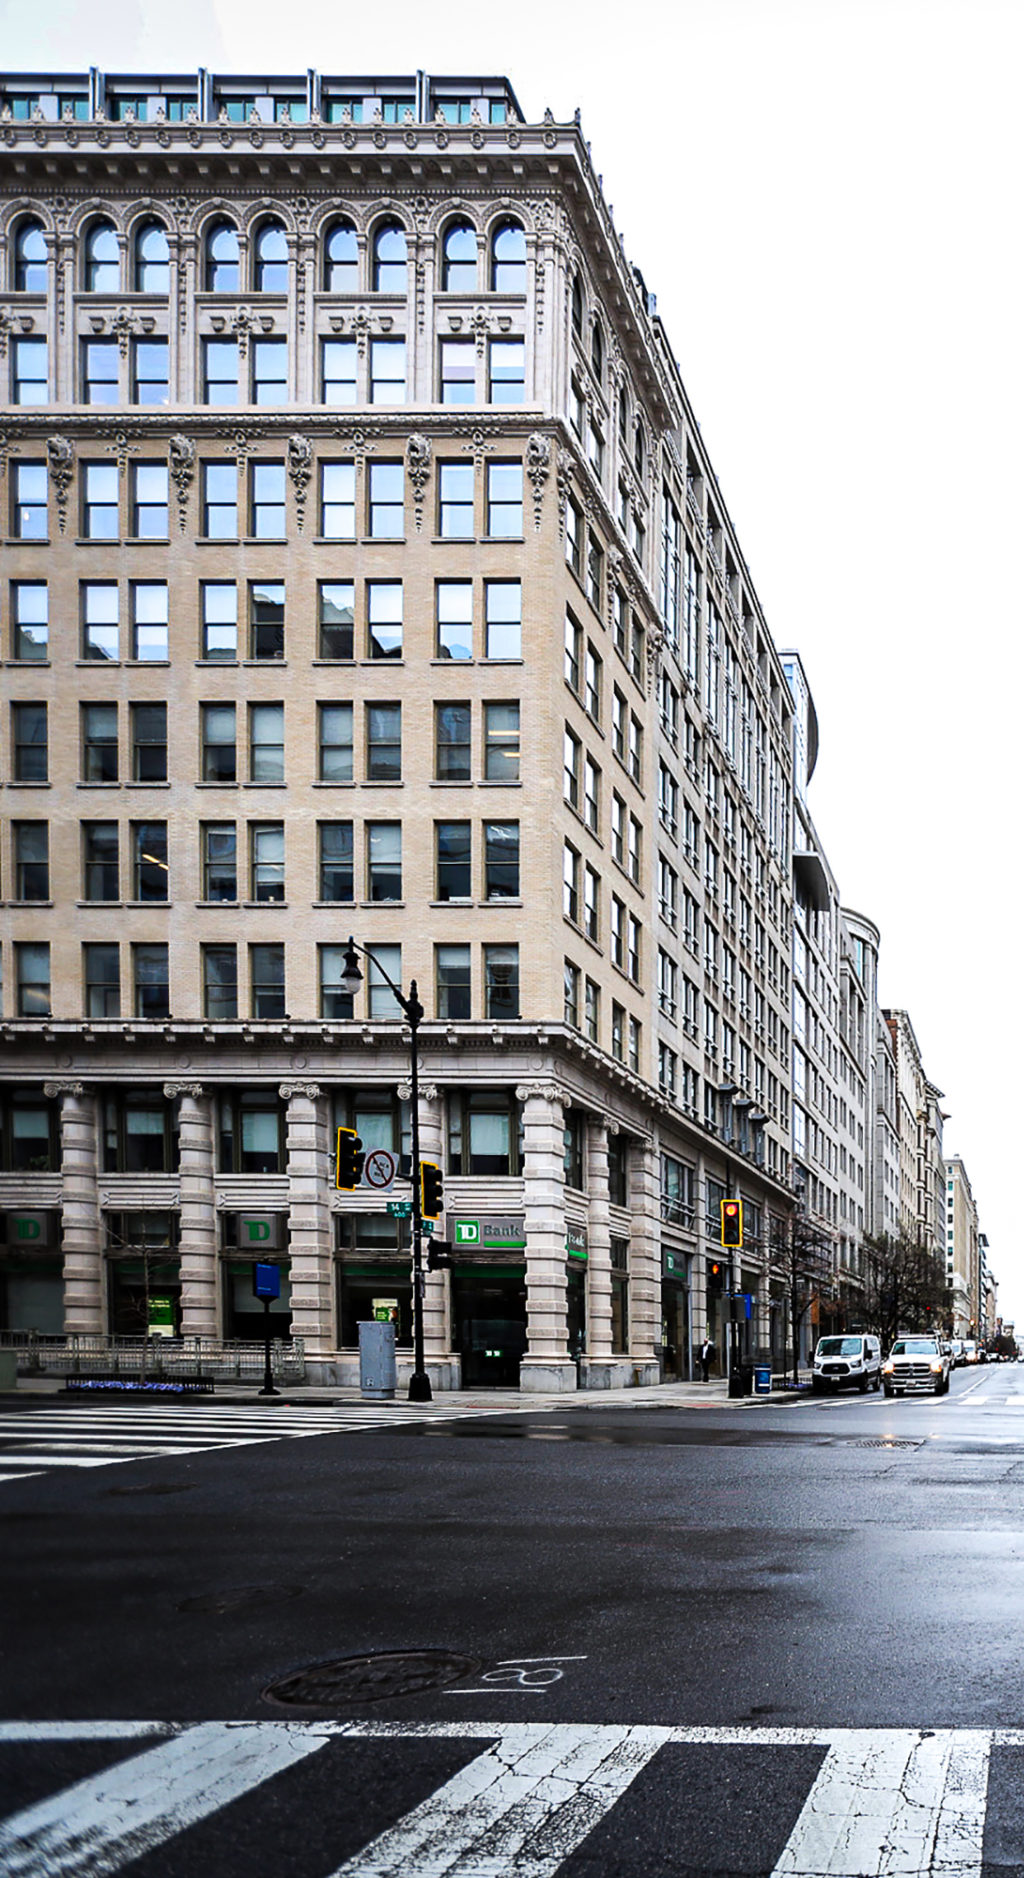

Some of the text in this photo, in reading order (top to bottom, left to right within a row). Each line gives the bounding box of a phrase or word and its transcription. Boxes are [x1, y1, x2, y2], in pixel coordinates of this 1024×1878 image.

[14, 1218, 41, 1239] TD
[243, 1220, 271, 1241] TD
[458, 1224, 520, 1240] TD Bank
